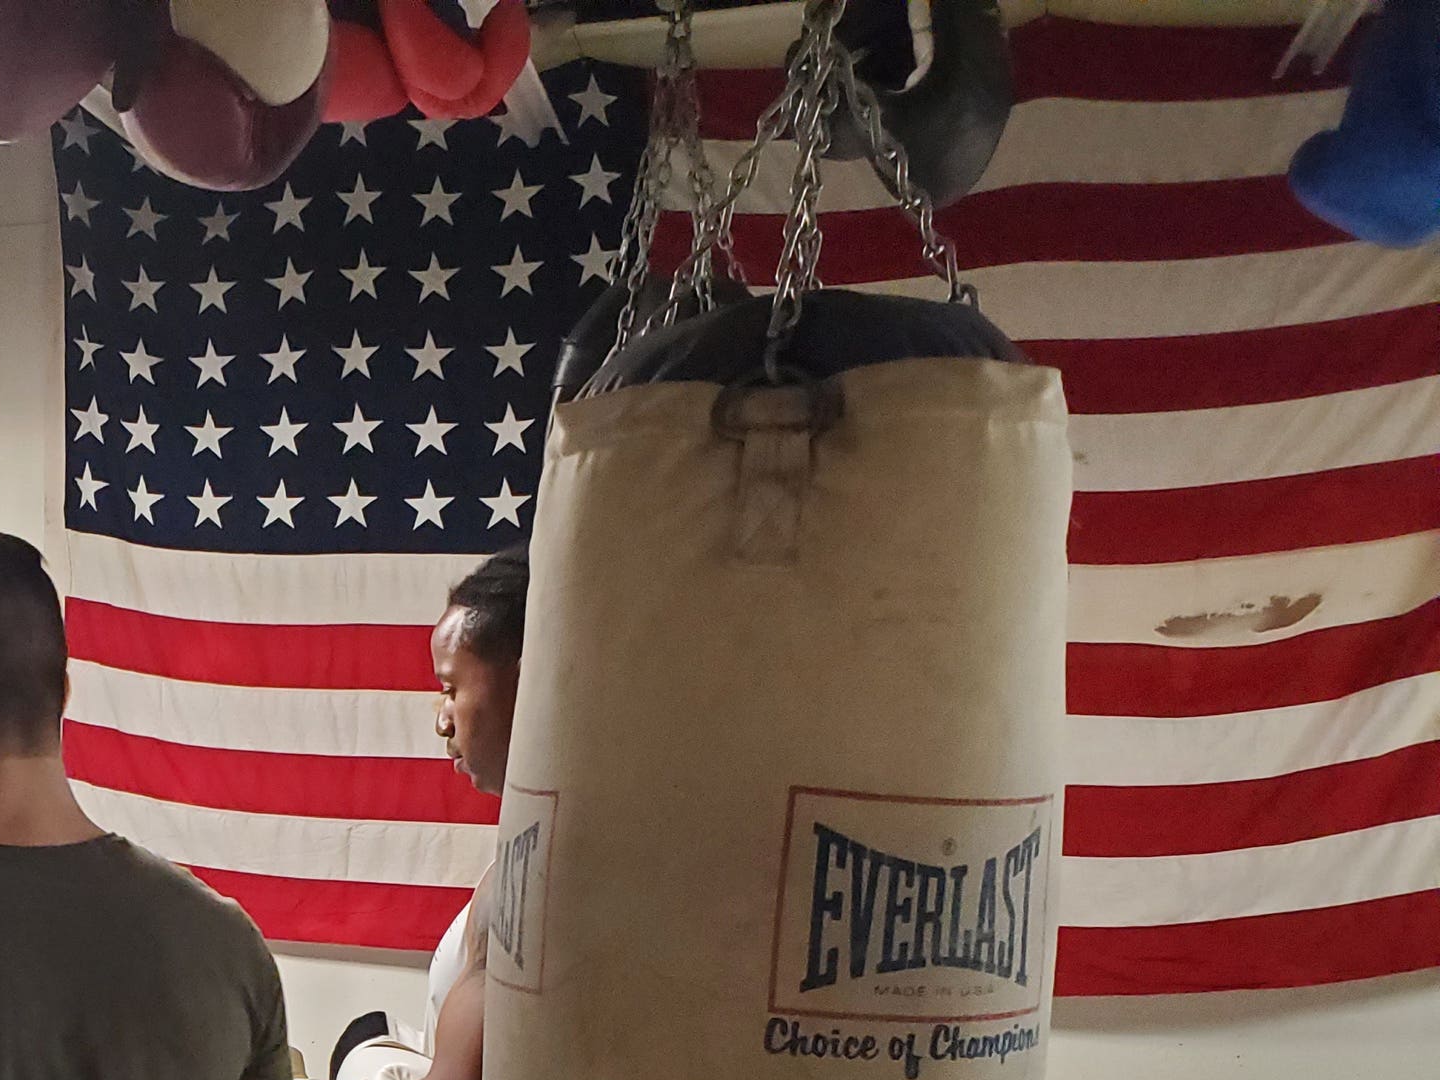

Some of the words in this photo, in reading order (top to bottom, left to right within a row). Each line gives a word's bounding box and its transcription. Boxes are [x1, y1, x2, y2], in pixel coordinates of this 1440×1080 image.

[799, 821, 1042, 993] EVERLAST
[874, 984, 927, 997] MADE
[764, 1016, 880, 1060] Choice
[889, 1032, 923, 1080] of
